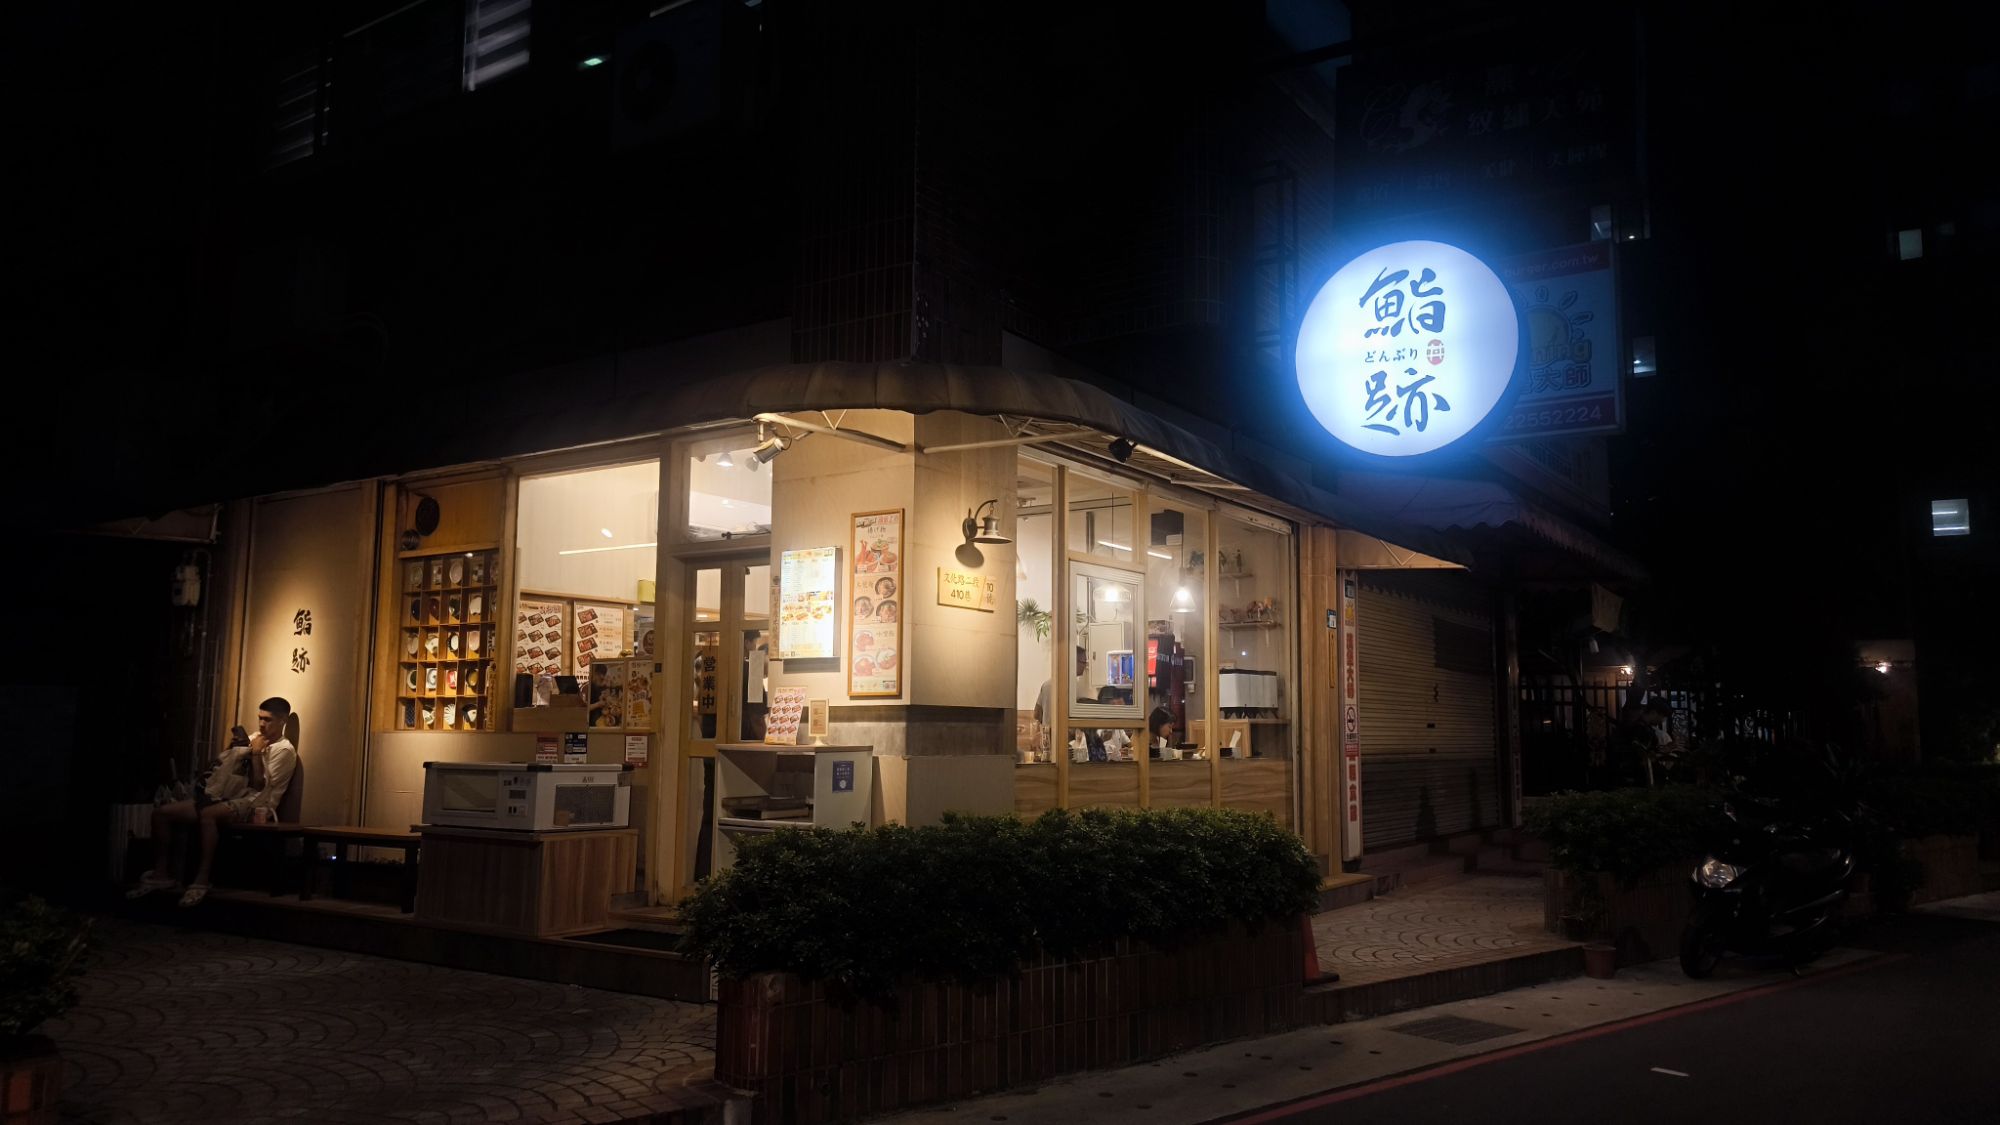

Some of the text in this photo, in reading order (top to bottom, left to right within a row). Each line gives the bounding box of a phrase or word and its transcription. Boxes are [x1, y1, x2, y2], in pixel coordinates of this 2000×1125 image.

[1364, 347, 1418, 363] どんぶり
[950, 589, 972, 602] 410巷
[702, 655, 716, 709] 營業中
